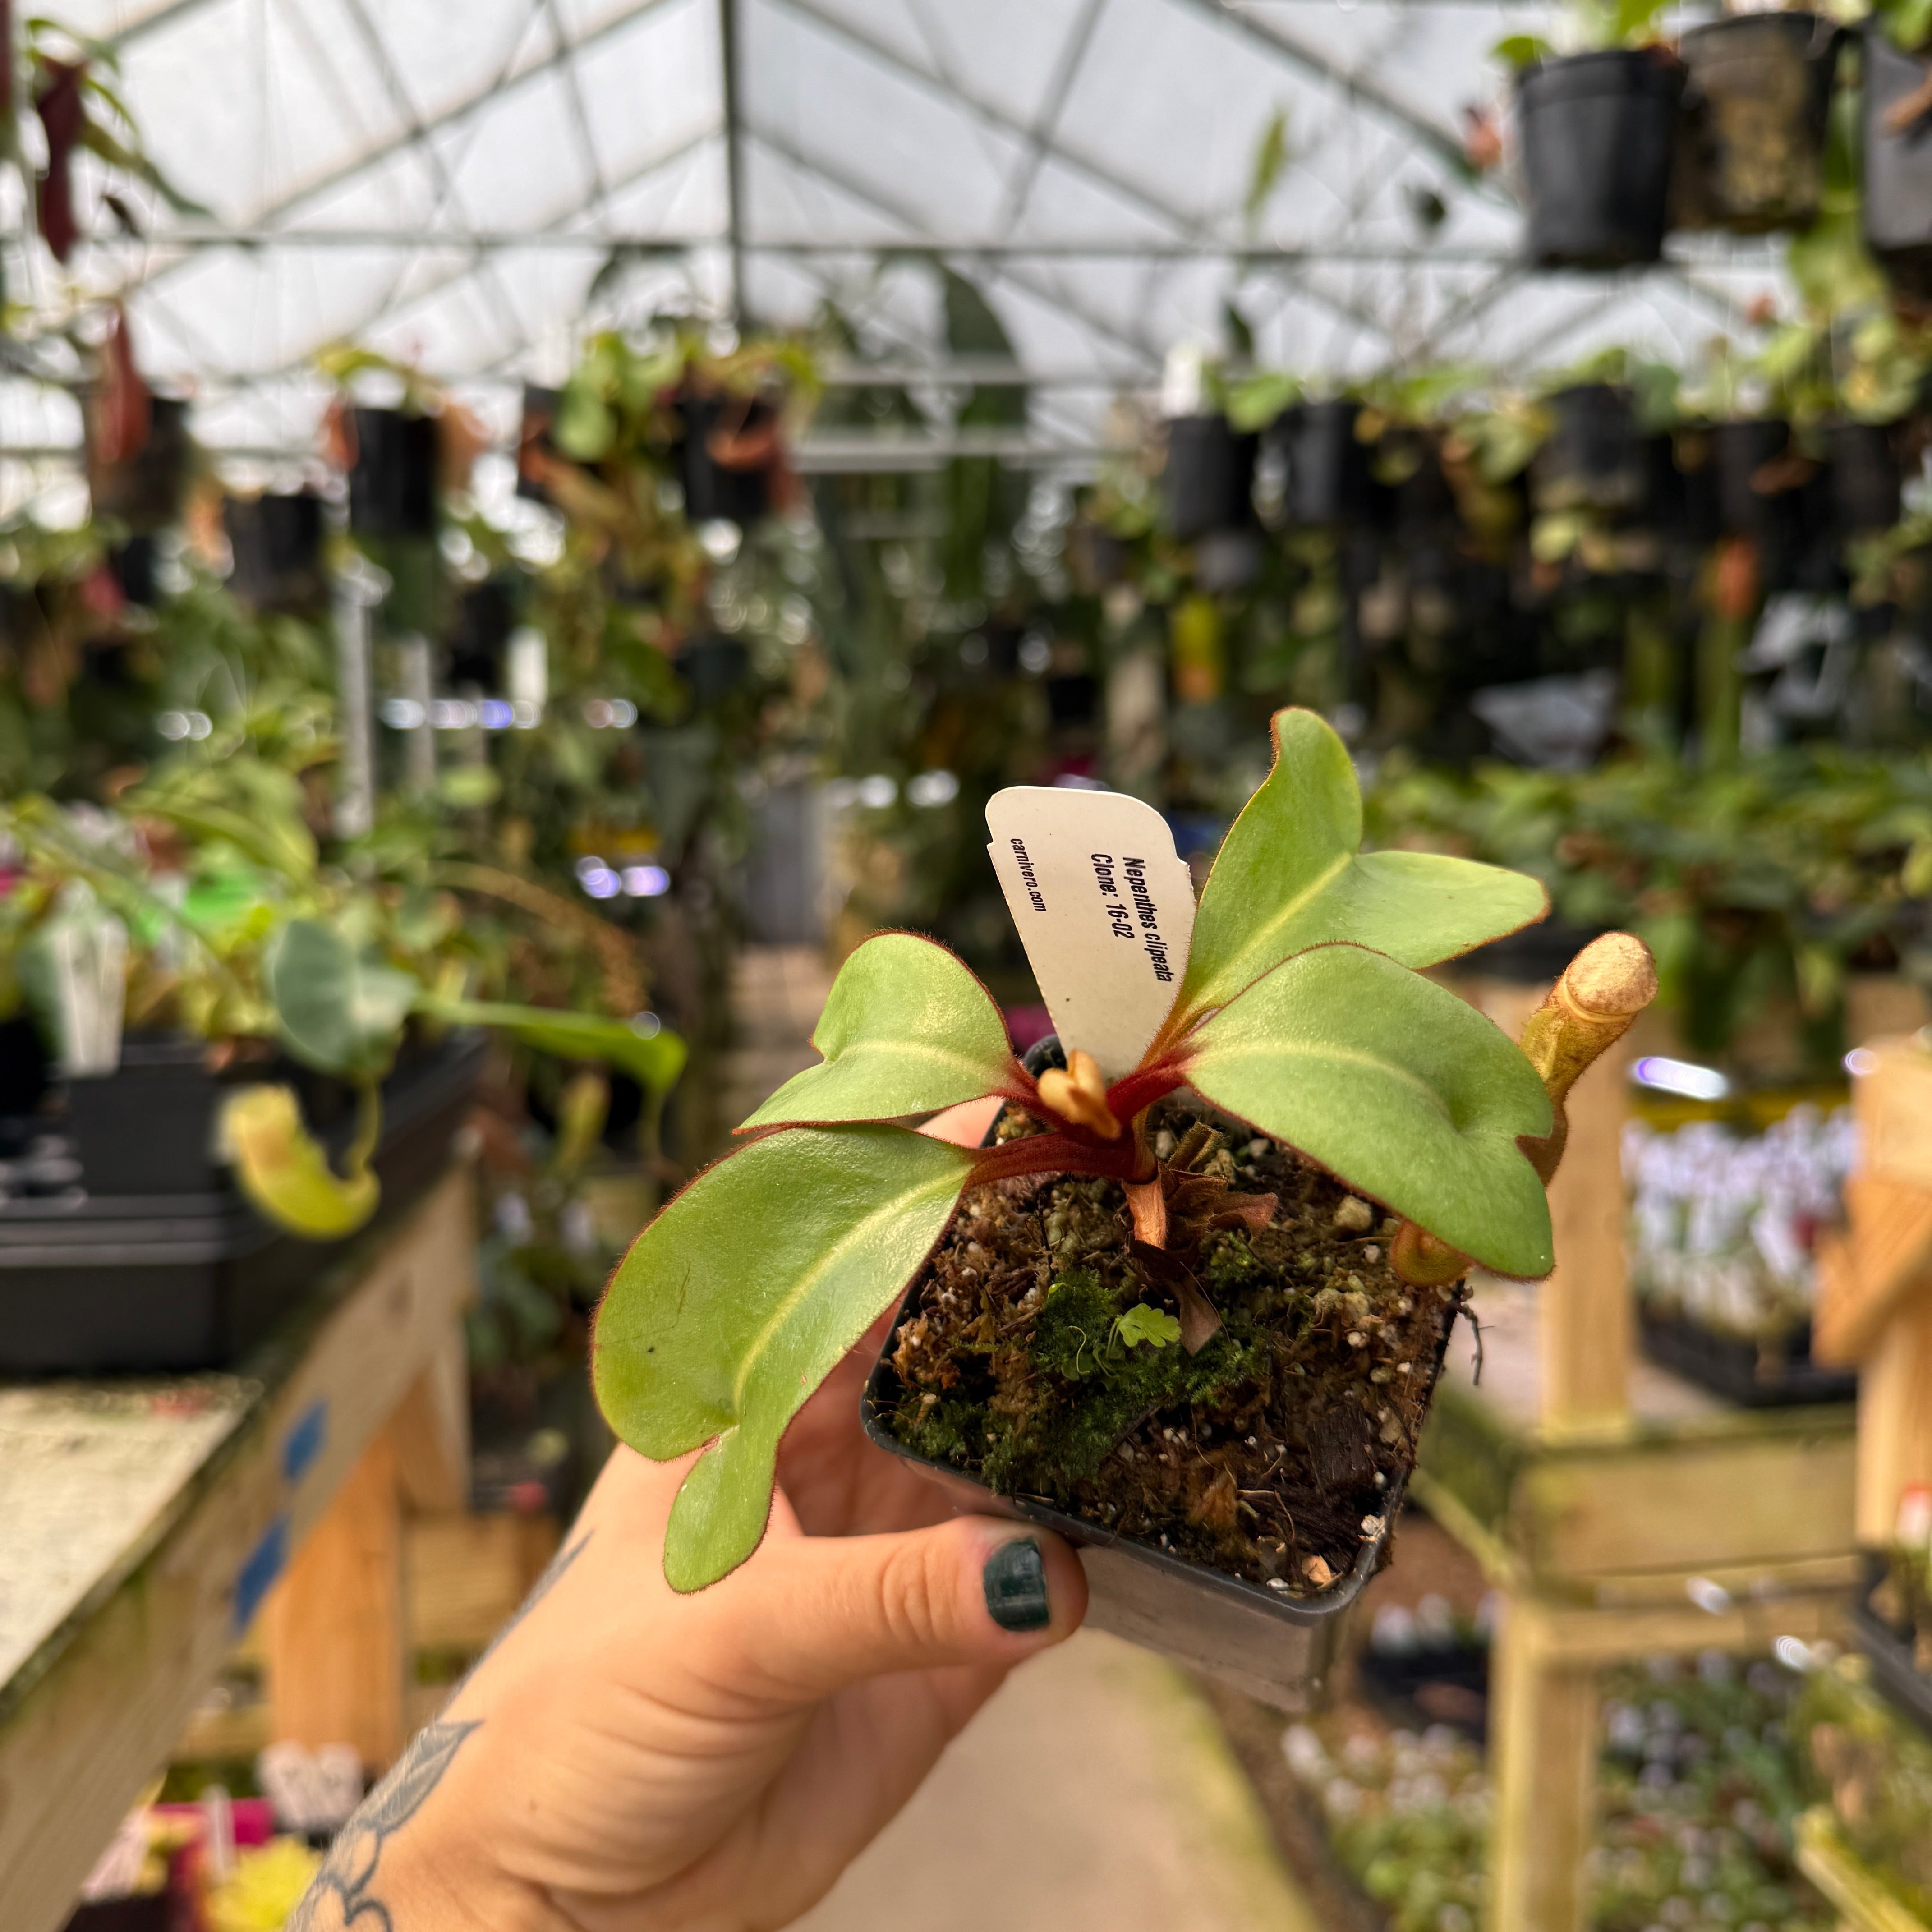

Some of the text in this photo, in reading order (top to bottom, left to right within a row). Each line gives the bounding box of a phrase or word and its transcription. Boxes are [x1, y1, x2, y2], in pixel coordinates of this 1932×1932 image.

[1010, 838, 1046, 911] carnivero.com
[1091, 853, 1135, 938] Clone: 16-02
[1123, 857, 1174, 982] Nepenthes clipeata
